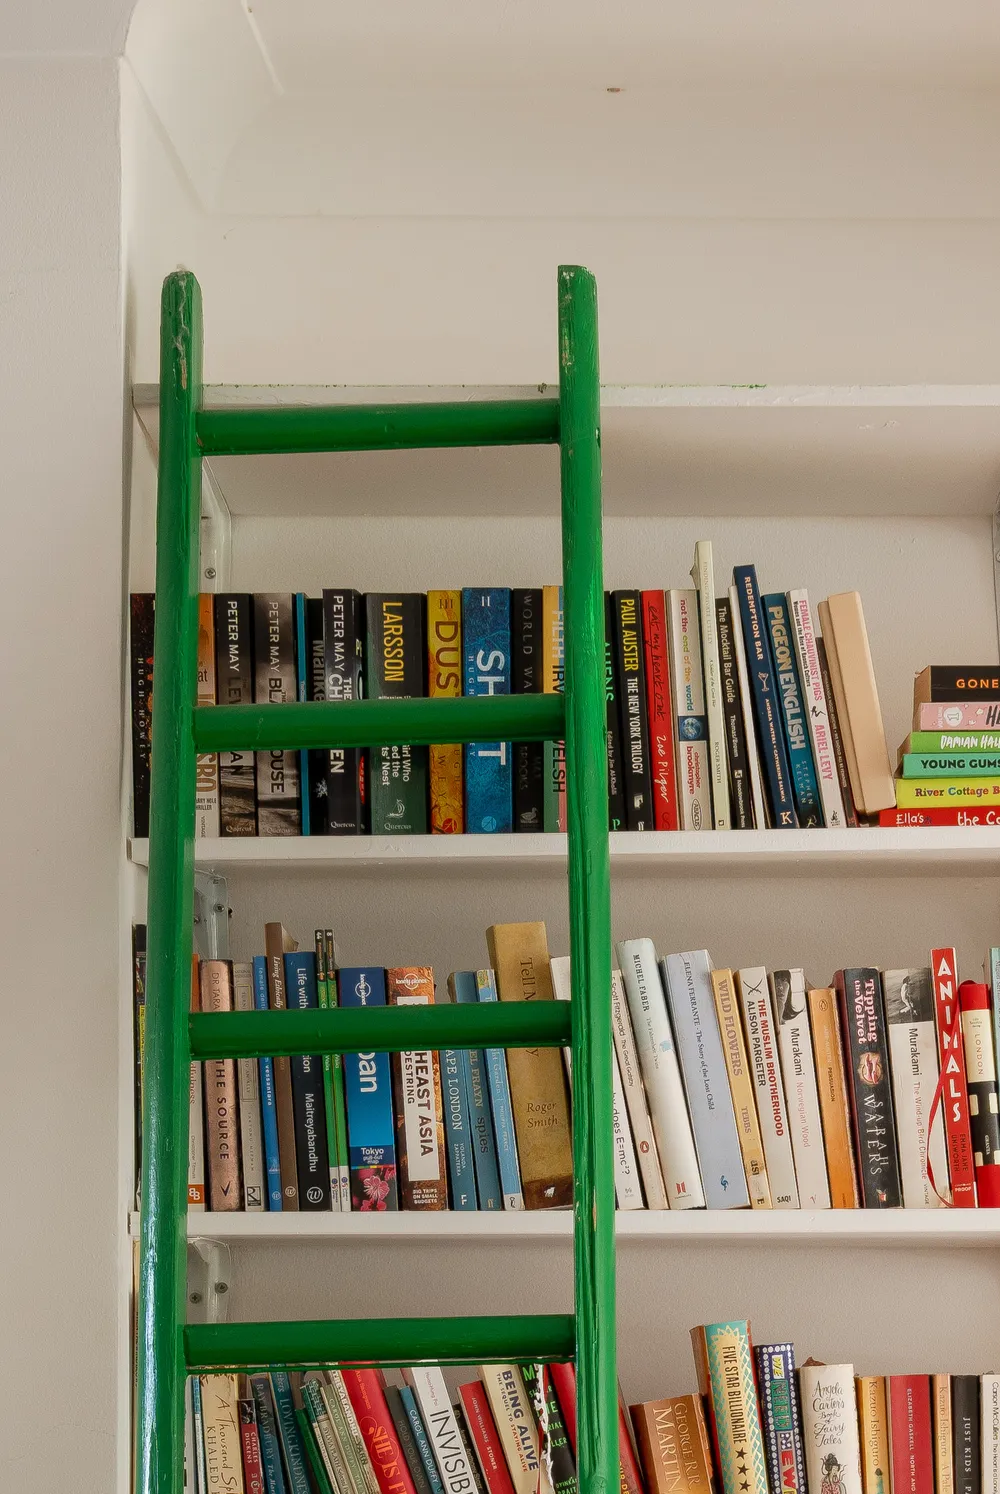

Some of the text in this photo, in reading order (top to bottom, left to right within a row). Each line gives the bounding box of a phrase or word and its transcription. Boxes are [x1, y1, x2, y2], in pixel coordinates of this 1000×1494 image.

[269, 602, 280, 672] PETER MAY
[383, 602, 404, 682] LARSSON
[719, 607, 735, 703] The Mocktail Bar Guide
[800, 600, 822, 700] FEMALE CHAUVINIST PIGS
[621, 599, 643, 774] PAUL AUSTER THE NEW YORK TRILOGY
[768, 606, 806, 750] PIGEON ENGLISH
[956, 679, 999, 689] GONE
[814, 725, 833, 780] ARIEL LEVY
[921, 760, 966, 769] YOUNG
[941, 735, 978, 749] DAMIAN
[896, 813, 924, 825] Ella's
[915, 787, 944, 797] River
[948, 786, 989, 797] Cottage
[957, 815, 979, 827] the
[632, 954, 649, 1011] MICHEL FABER
[684, 962, 700, 1026] ELENA FERRANTE
[863, 979, 878, 1042] Tipping
[718, 979, 742, 1076] WILD FLOWERS
[747, 1000, 766, 1087] ALISON PARGETER
[854, 995, 868, 1044] Velvet
[758, 999, 784, 1136] THE MUSLIM BROTHERHOOD
[790, 1028, 811, 1148] Murakami Norwegian Wood
[975, 1034, 984, 1075] LONDON
[215, 1061, 229, 1160] THE SOURCE
[304, 1093, 318, 1172] Maitreyabandhu
[863, 1094, 881, 1175] WATERS
[874, 1102, 889, 1167] SARAH
[215, 1395, 230, 1410] A
[722, 1346, 747, 1443] FIVE STAR BILLIONAIRE
[206, 1426, 218, 1484] KHALED
[215, 1413, 236, 1469] Thousand
[652, 1406, 684, 1494] MARTIN
[673, 1402, 700, 1490] GEORGE R.R.
